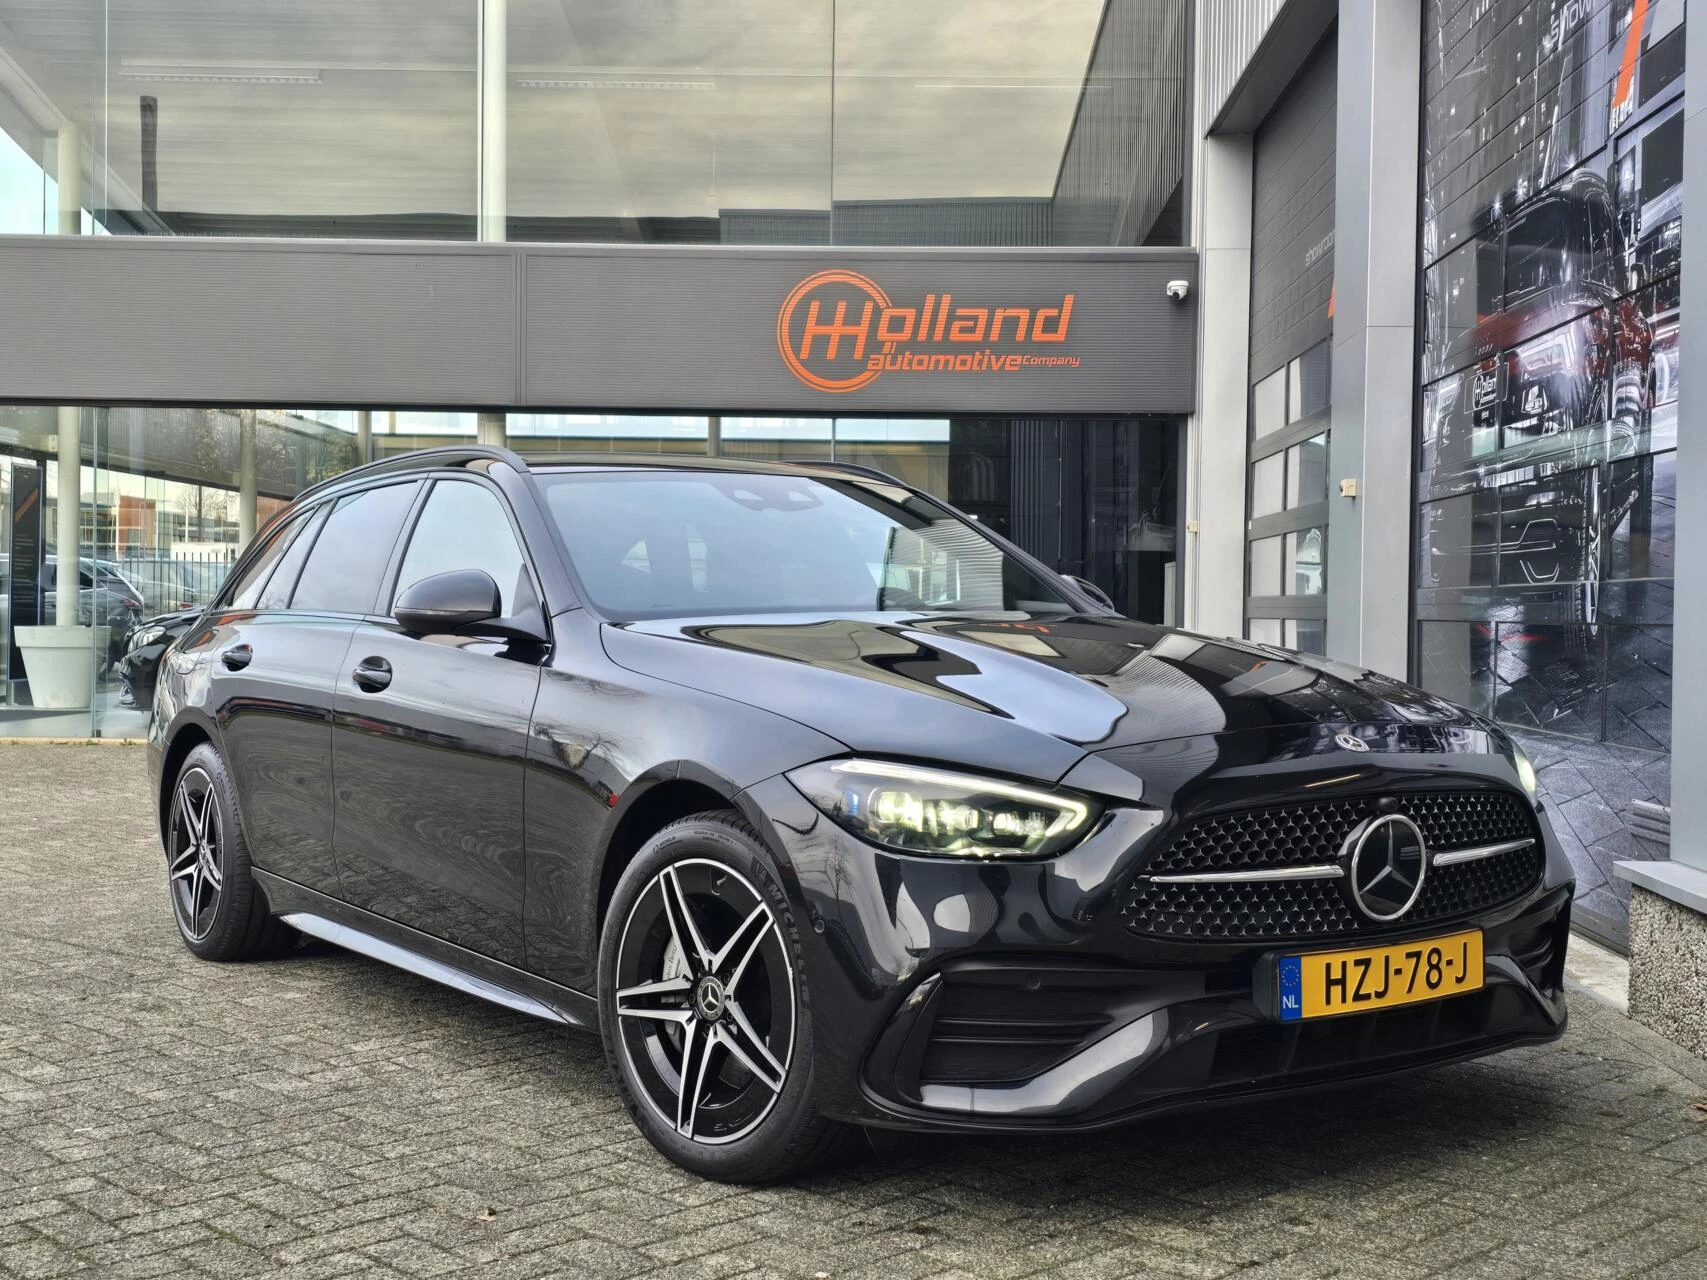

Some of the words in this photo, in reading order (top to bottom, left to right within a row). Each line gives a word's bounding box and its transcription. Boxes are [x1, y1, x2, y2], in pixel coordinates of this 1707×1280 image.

[866, 349, 1023, 372] automotive
[1021, 355, 1081, 368] Company
[1324, 941, 1468, 1006] HZJ-78-J
[1282, 994, 1299, 1009] NL
